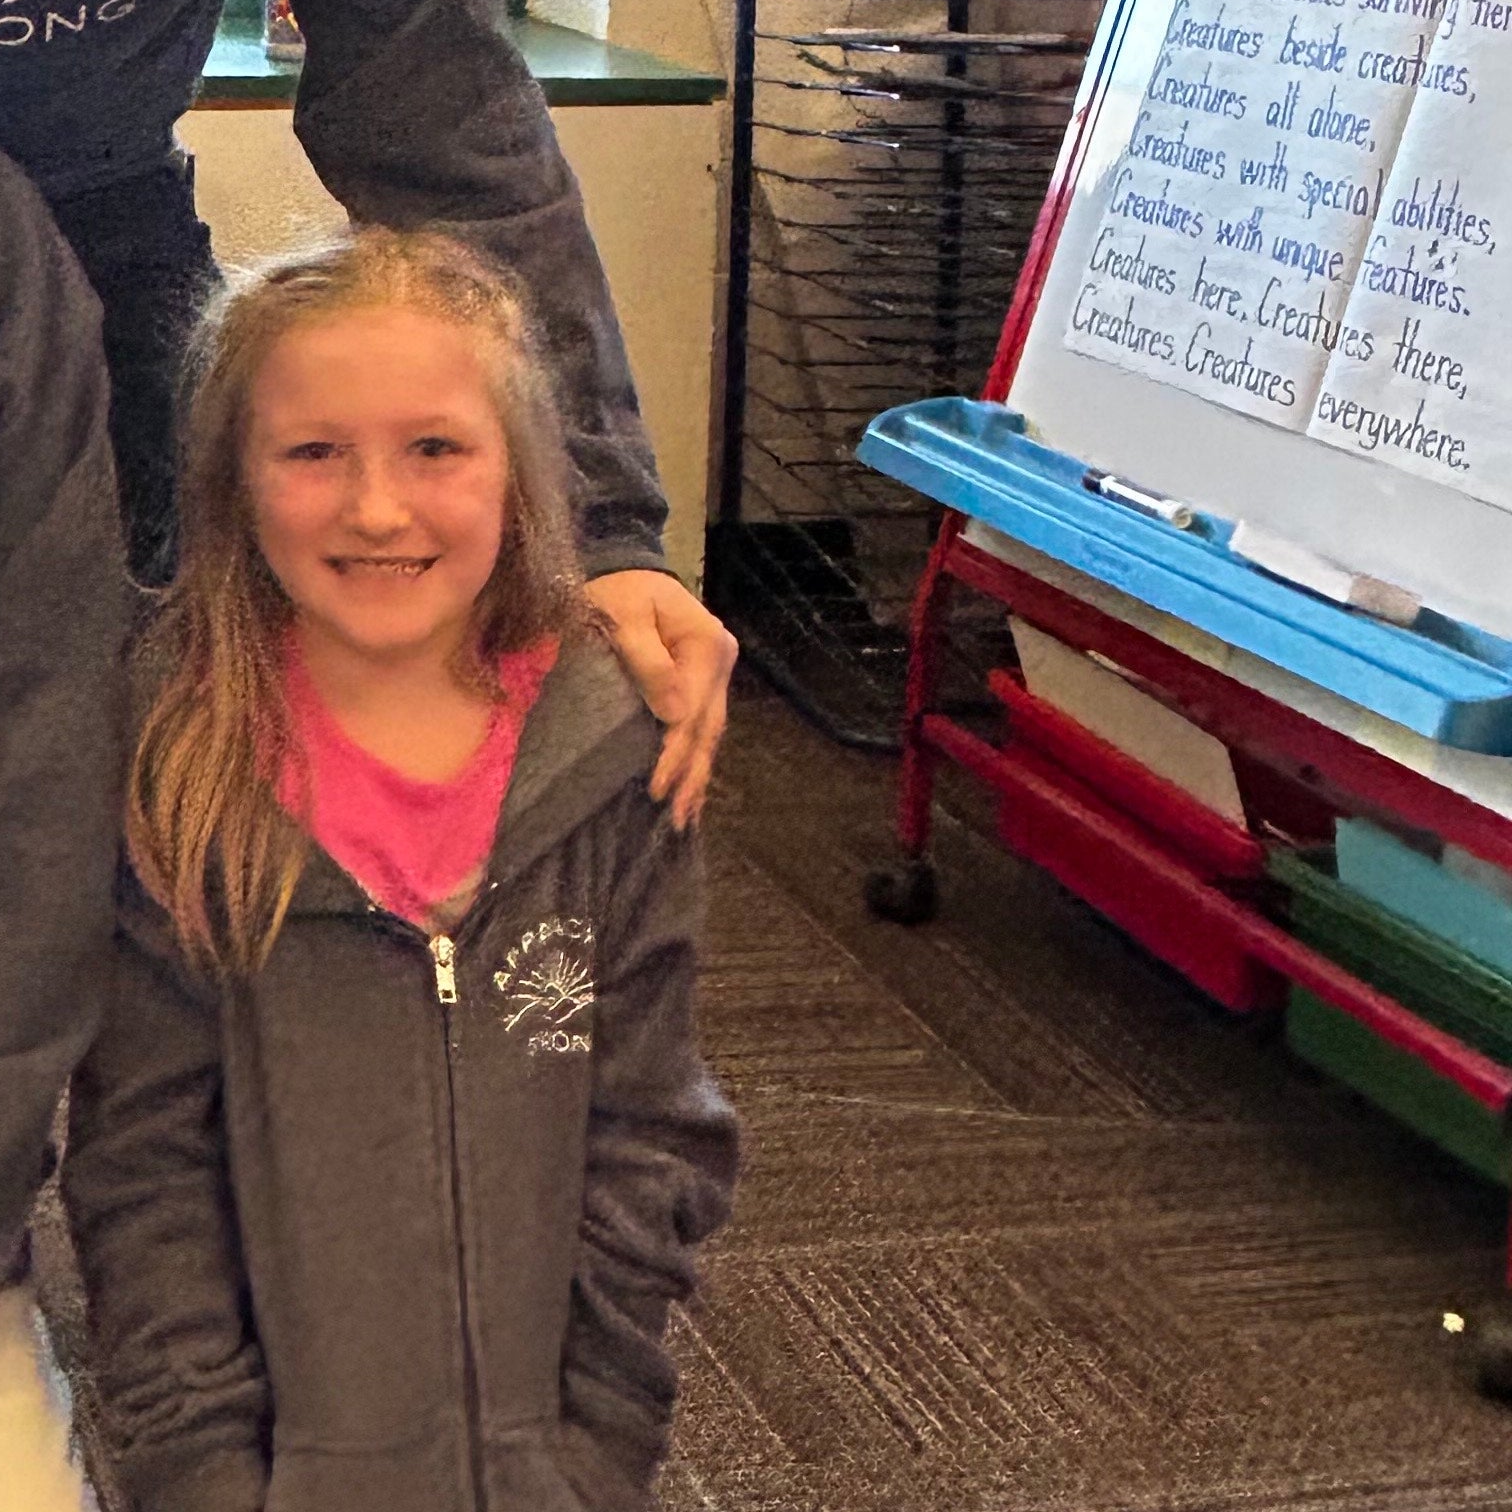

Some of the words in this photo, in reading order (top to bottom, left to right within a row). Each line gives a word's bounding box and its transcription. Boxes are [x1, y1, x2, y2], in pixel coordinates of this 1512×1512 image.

[1146, 52, 1247, 120] Creatures
[1265, 81, 1301, 130] all
[1279, 14, 1347, 73] beside
[1129, 110, 1226, 179] Creatures
[1240, 141, 1288, 193] with
[1297, 168, 1384, 220] special
[1109, 168, 1204, 238] Creatures
[1215, 206, 1264, 254] with
[1272, 234, 1344, 283] unique
[1088, 226, 1177, 296] Creatures
[1257, 276, 1375, 362] Creatures
[1185, 321, 1296, 407] Creatures
[1317, 391, 1471, 471] everywhere.
